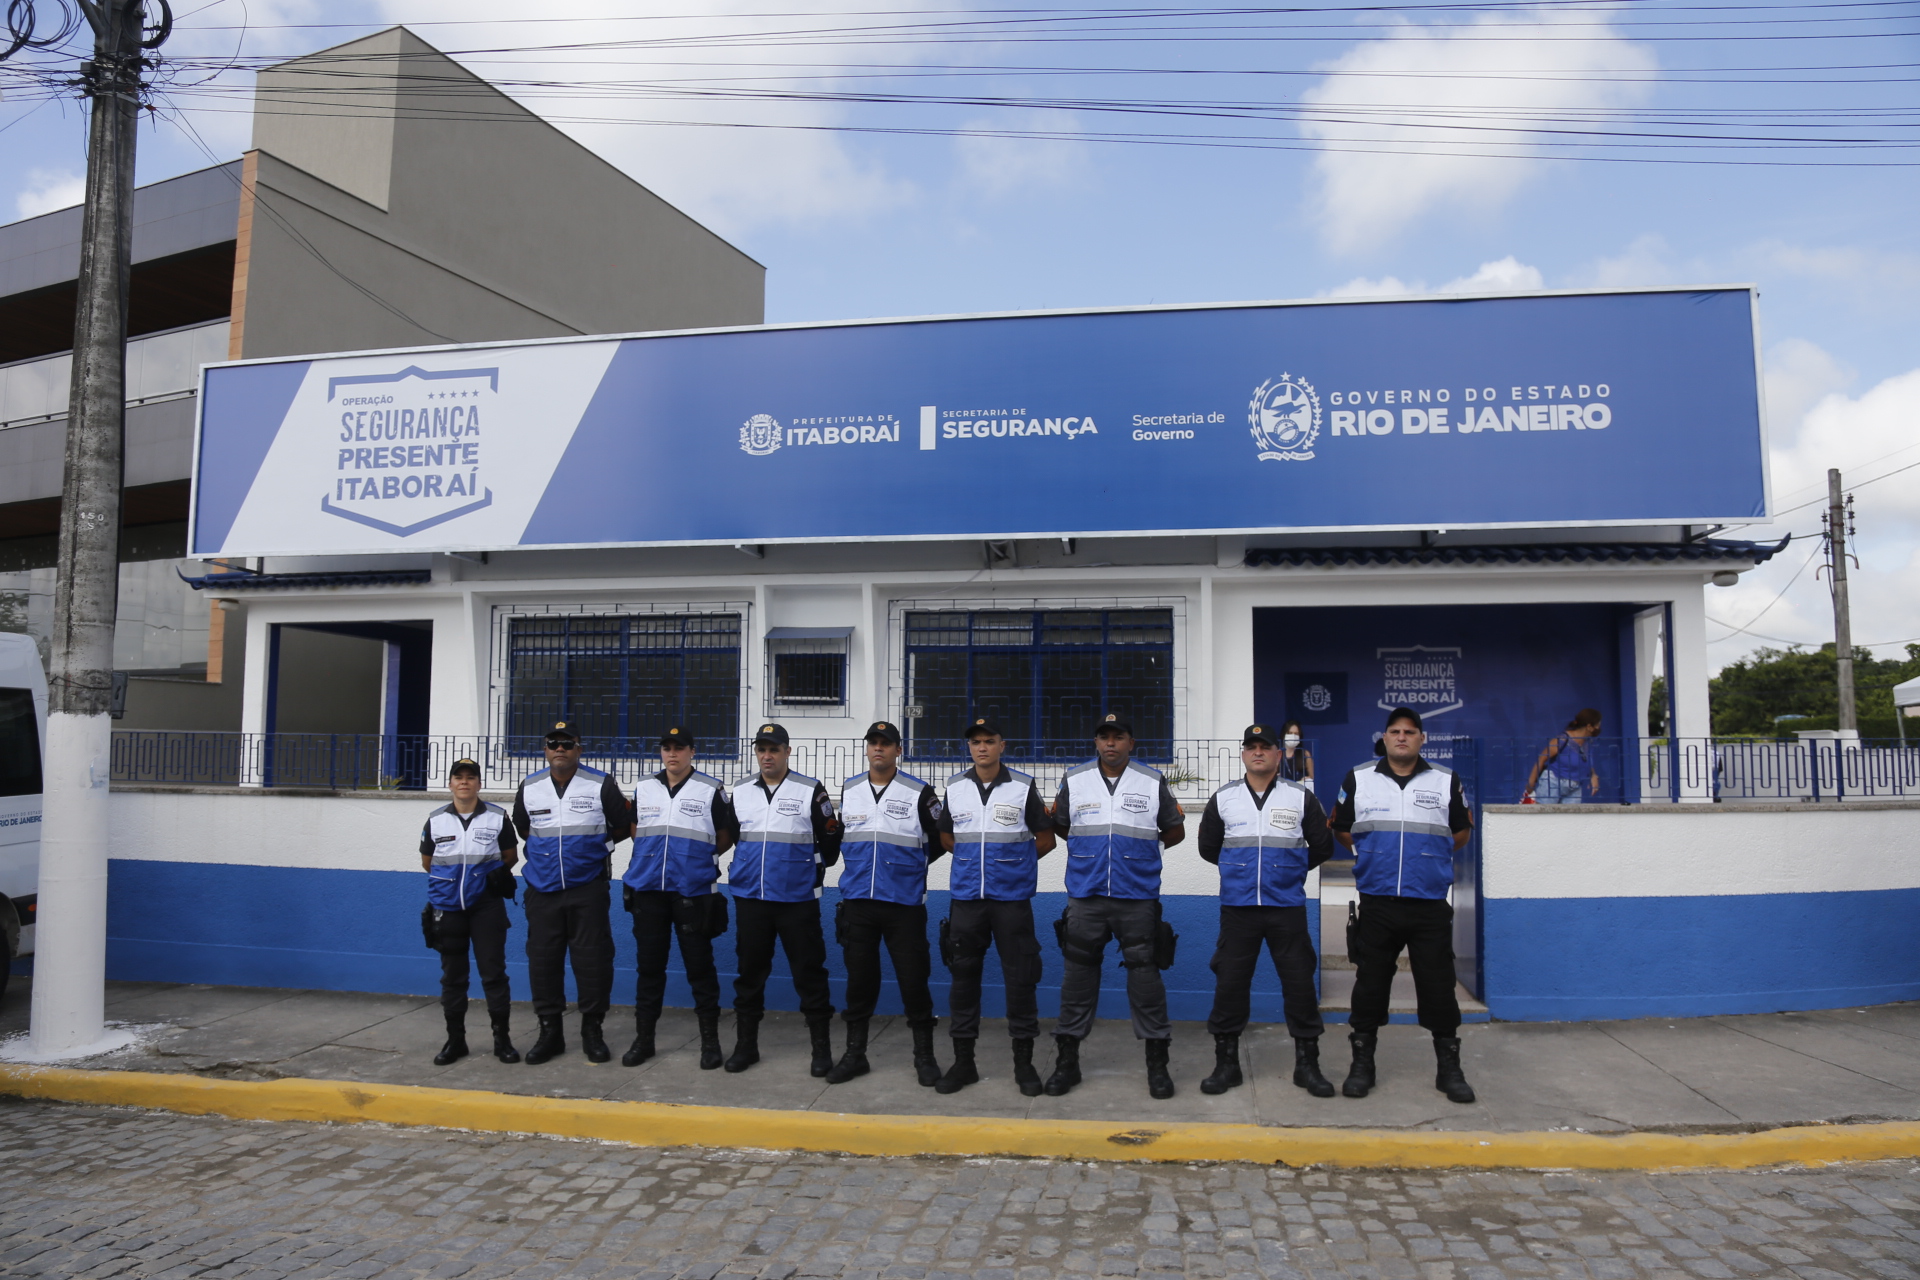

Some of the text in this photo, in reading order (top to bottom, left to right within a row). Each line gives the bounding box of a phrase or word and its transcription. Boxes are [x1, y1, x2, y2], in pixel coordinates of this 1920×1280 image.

[342, 395, 394, 406] OPERAÇÃO
[1330, 383, 1610, 405] GOVERNO DO ESTADO
[793, 415, 873, 425] PREFEITURA
[942, 409, 1008, 418] SECRETARIA
[1132, 411, 1225, 426] Secretaria de
[1331, 409, 1395, 436] RIO
[1401, 408, 1450, 434] DE
[1457, 403, 1612, 434] JANEIRO
[340, 405, 480, 443] SEGURANÇA
[942, 416, 1098, 440] SEGURANÇA
[787, 420, 900, 446] ITABORAÍ
[1132, 428, 1194, 441] Governo
[338, 443, 479, 470] PRESENTE
[336, 466, 479, 501] ITABORAÍ
[1384, 663, 1455, 679] SEGURANÇA
[1385, 679, 1455, 690] PRESENTE
[1385, 689, 1456, 703] ITABORAÍ
[907, 707, 921, 716] 129
[10, 818, 18, 826] DE
